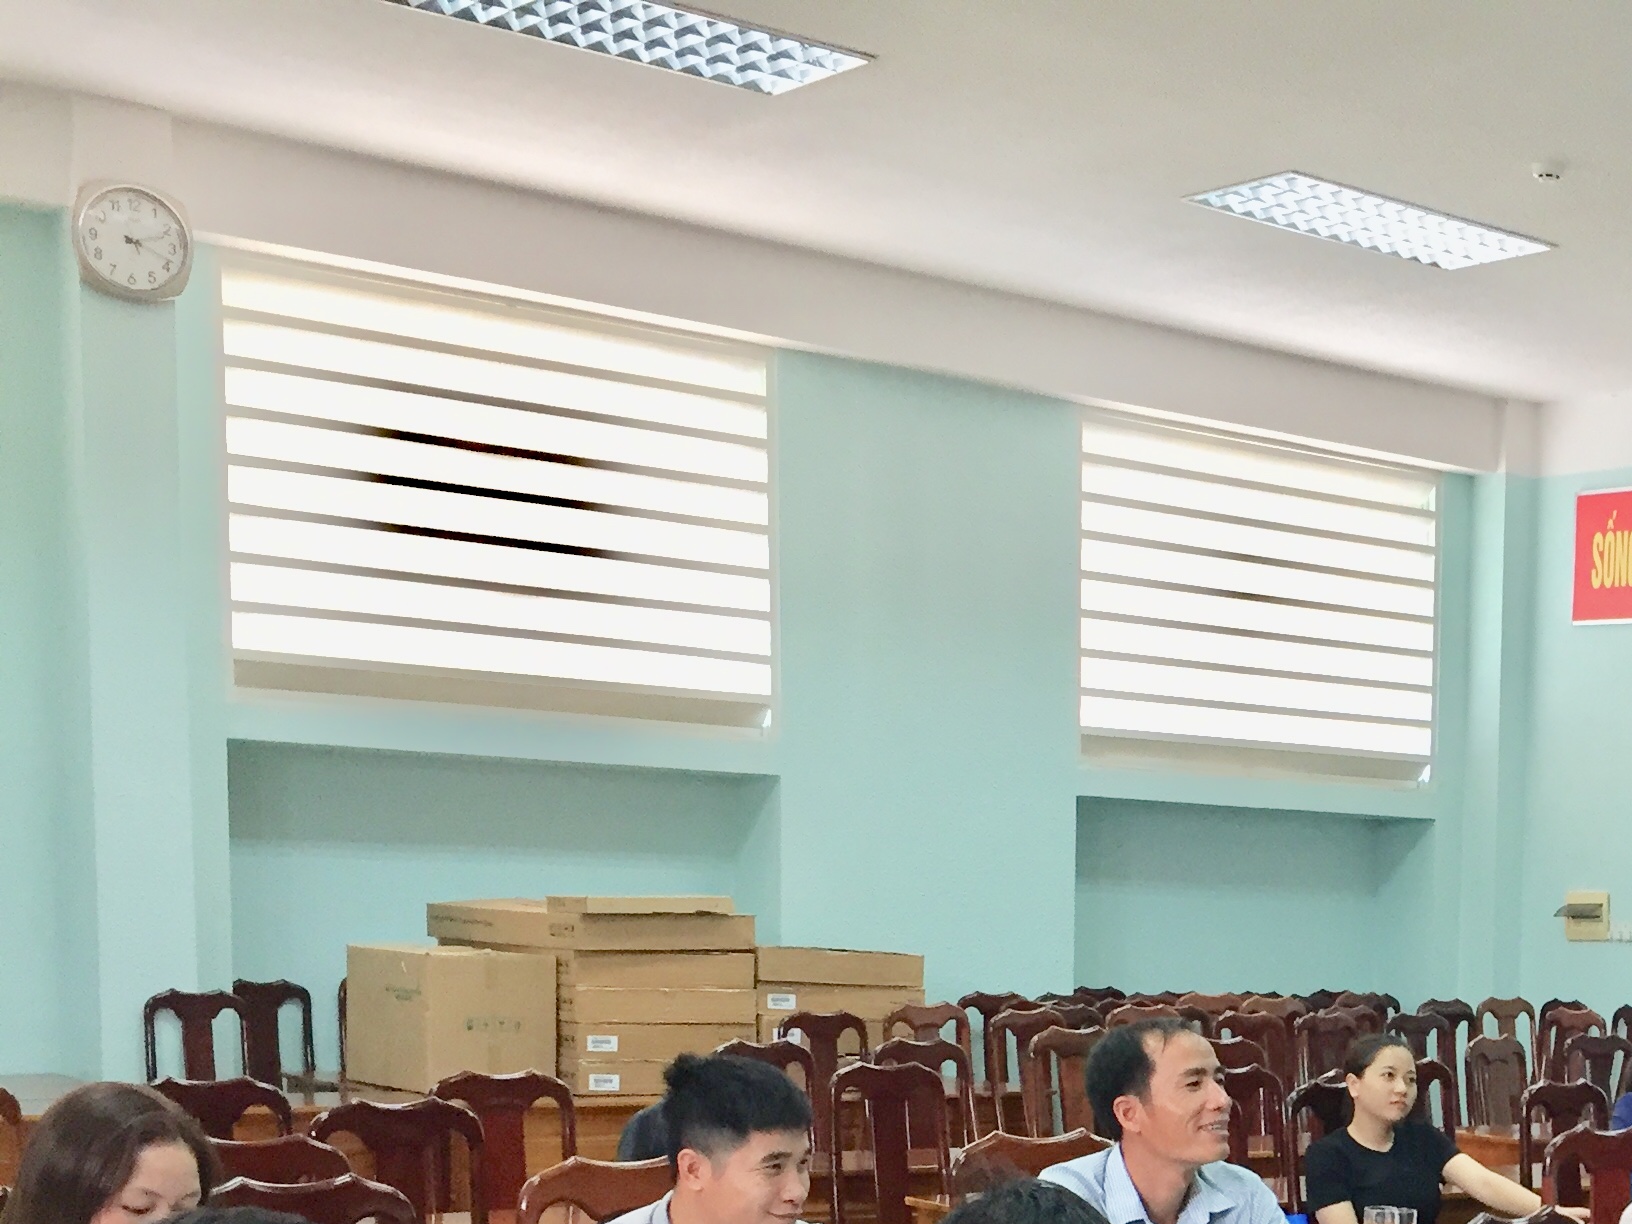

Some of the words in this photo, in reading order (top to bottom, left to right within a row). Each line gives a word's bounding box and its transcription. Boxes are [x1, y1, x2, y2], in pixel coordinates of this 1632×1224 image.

[127, 198, 141, 212] 12
[88, 226, 98, 241] 9
[163, 223, 172, 237] 2
[94, 246, 103, 261] 8
[168, 242, 177, 256] 3
[109, 262, 117, 276] 7
[127, 272, 137, 285] 6
[147, 270, 157, 284] 5
